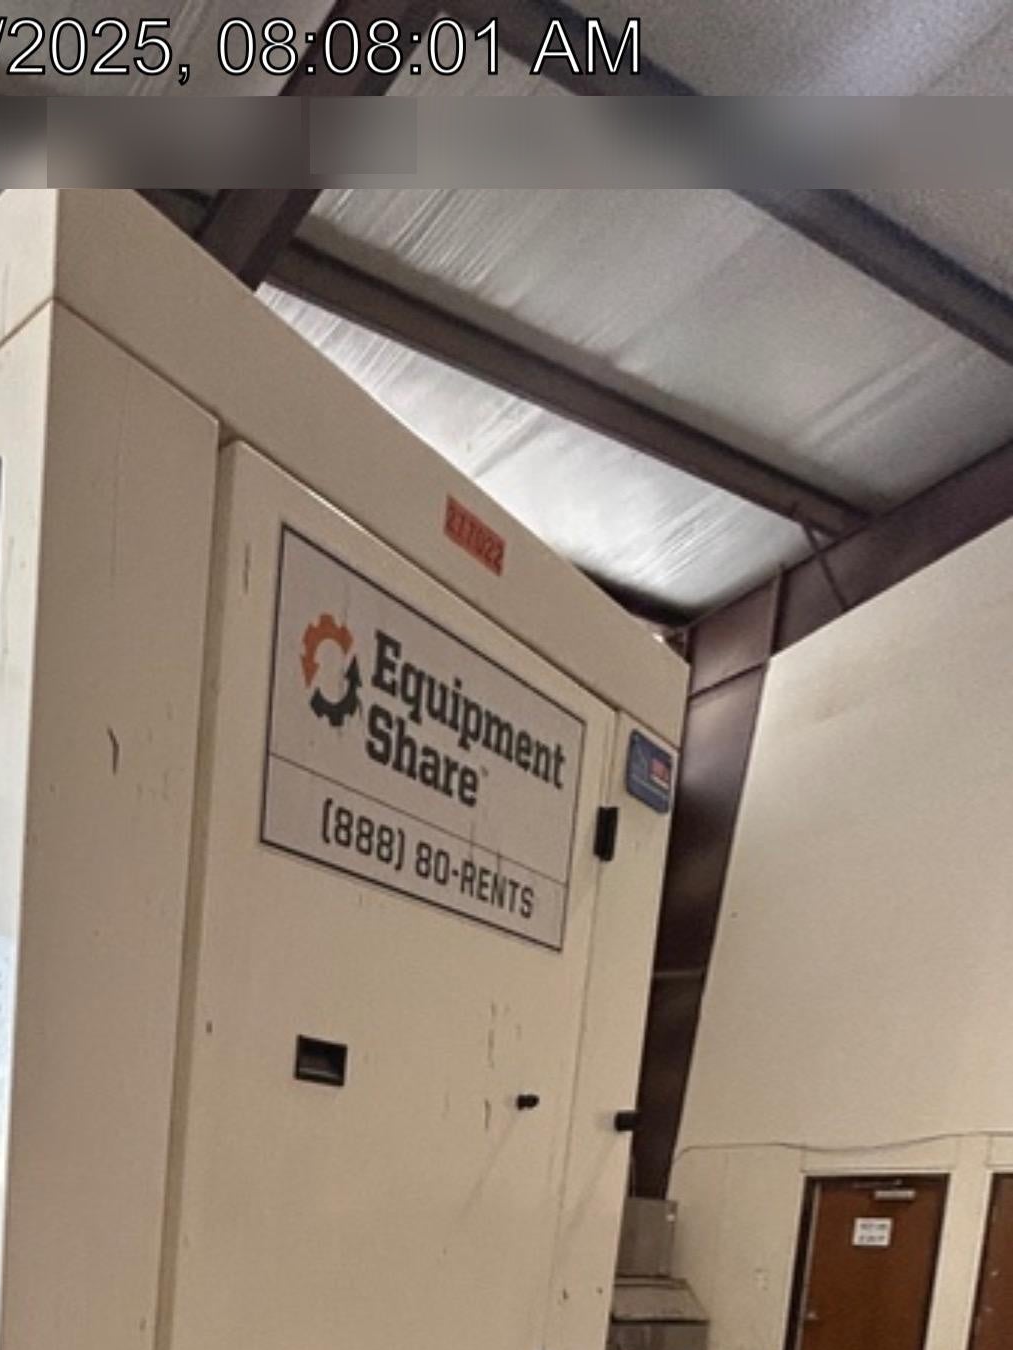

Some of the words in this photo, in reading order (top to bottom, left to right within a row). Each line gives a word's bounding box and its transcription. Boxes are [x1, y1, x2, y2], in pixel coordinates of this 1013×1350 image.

[366, 703, 479, 808] Share
[372, 629, 565, 790] Equipment
[321, 797, 405, 870] (888)
[415, 842, 534, 919] 80-RENTS
